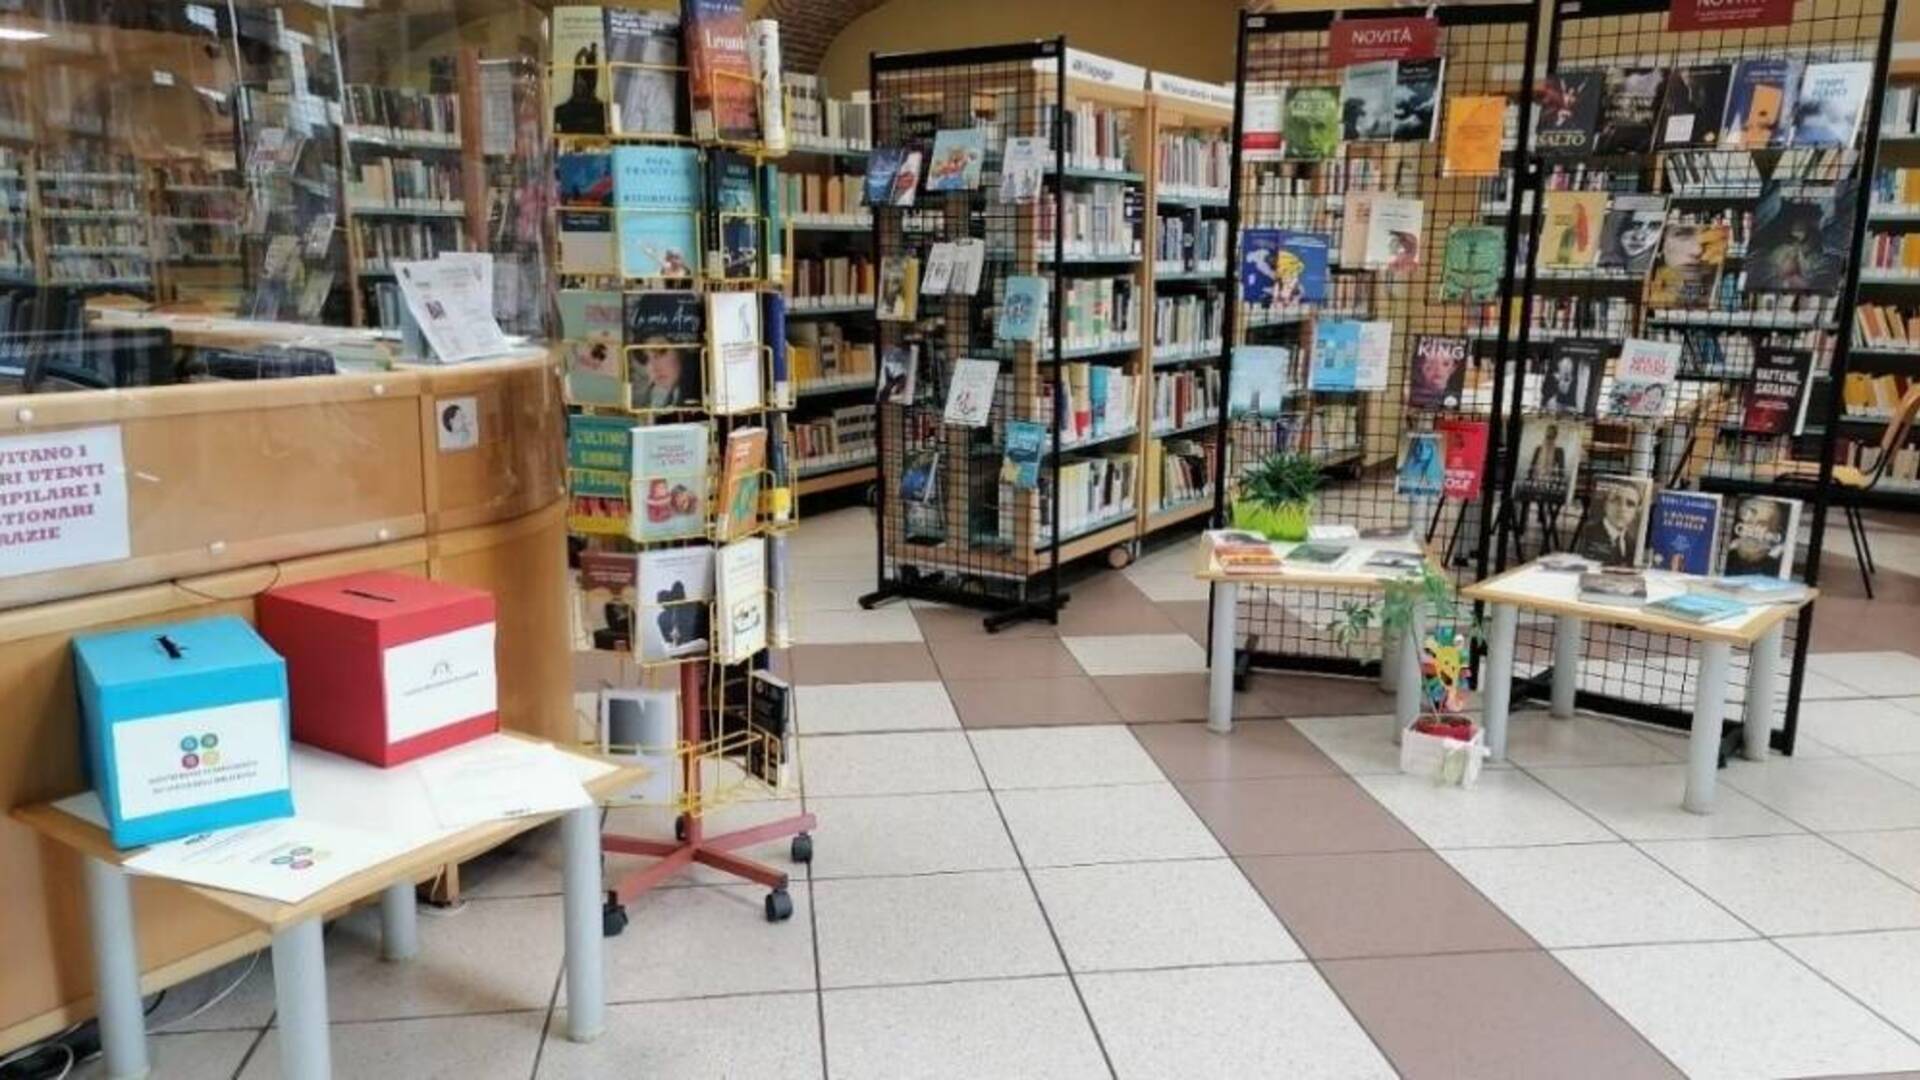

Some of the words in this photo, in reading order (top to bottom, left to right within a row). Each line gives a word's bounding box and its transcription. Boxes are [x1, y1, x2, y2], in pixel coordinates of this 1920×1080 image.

[1417, 338, 1465, 360] KING
[27, 462, 105, 483] UTENTI
[0, 503, 94, 527] TIONARI
